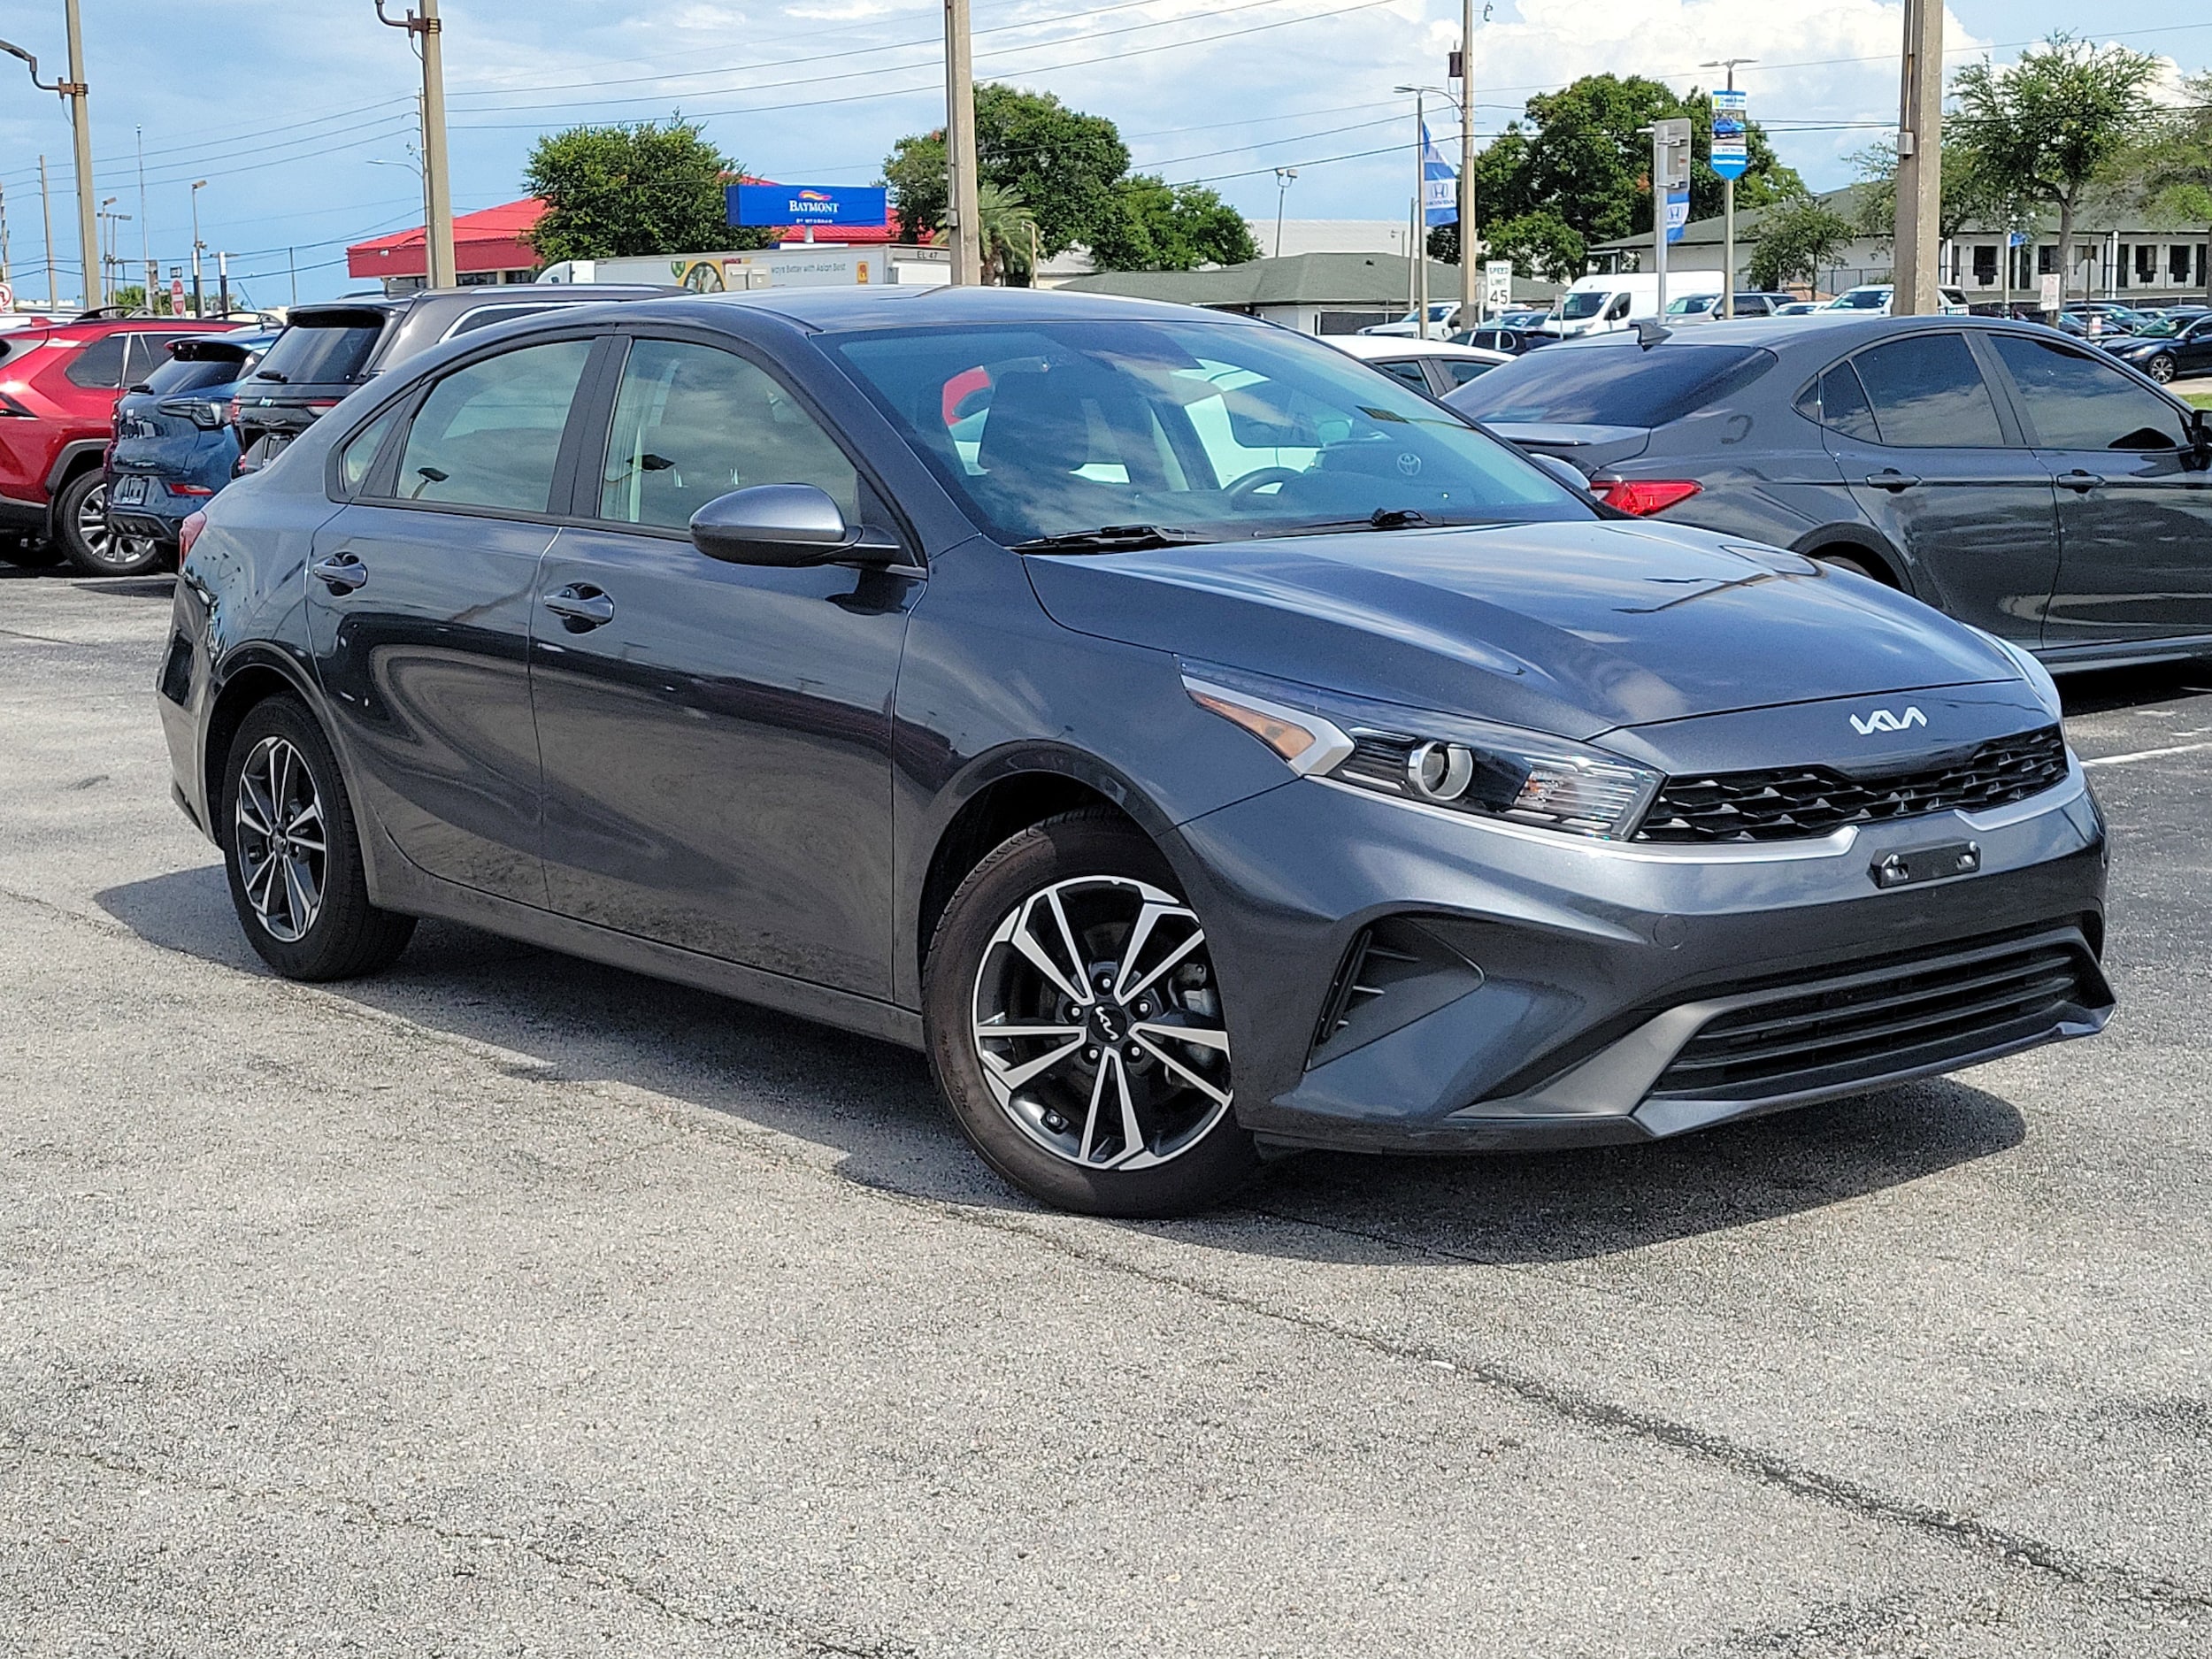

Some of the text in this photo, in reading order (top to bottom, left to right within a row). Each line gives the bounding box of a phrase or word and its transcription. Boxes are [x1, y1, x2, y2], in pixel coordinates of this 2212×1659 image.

[788, 200, 840, 212] BAYMONT
[1489, 289, 1508, 305] 45
[1849, 706, 1928, 735] KIA
